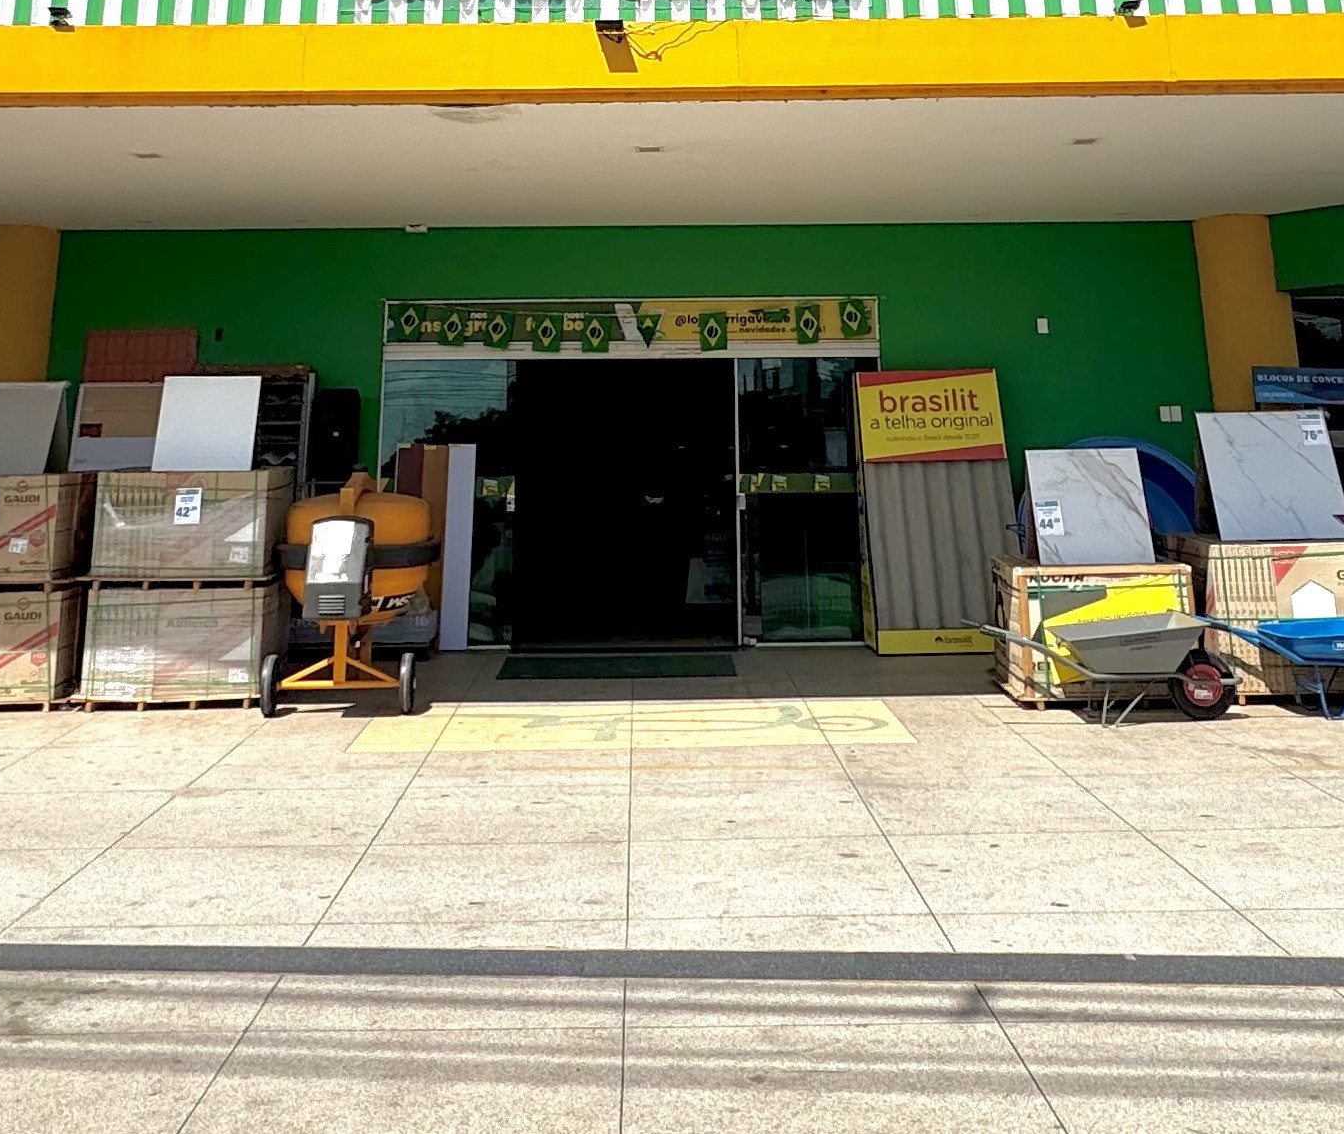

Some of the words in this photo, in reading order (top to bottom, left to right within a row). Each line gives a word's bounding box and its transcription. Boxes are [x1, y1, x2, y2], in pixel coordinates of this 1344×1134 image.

[1257, 373, 1295, 383] BLOCOS
[1296, 374, 1311, 383] DE
[878, 388, 980, 413] brasilit
[870, 418, 880, 430] a
[885, 414, 927, 430] telha
[931, 412, 994, 431] original
[4, 494, 41, 504] GAUDI
[4, 611, 42, 622] GAUDI
